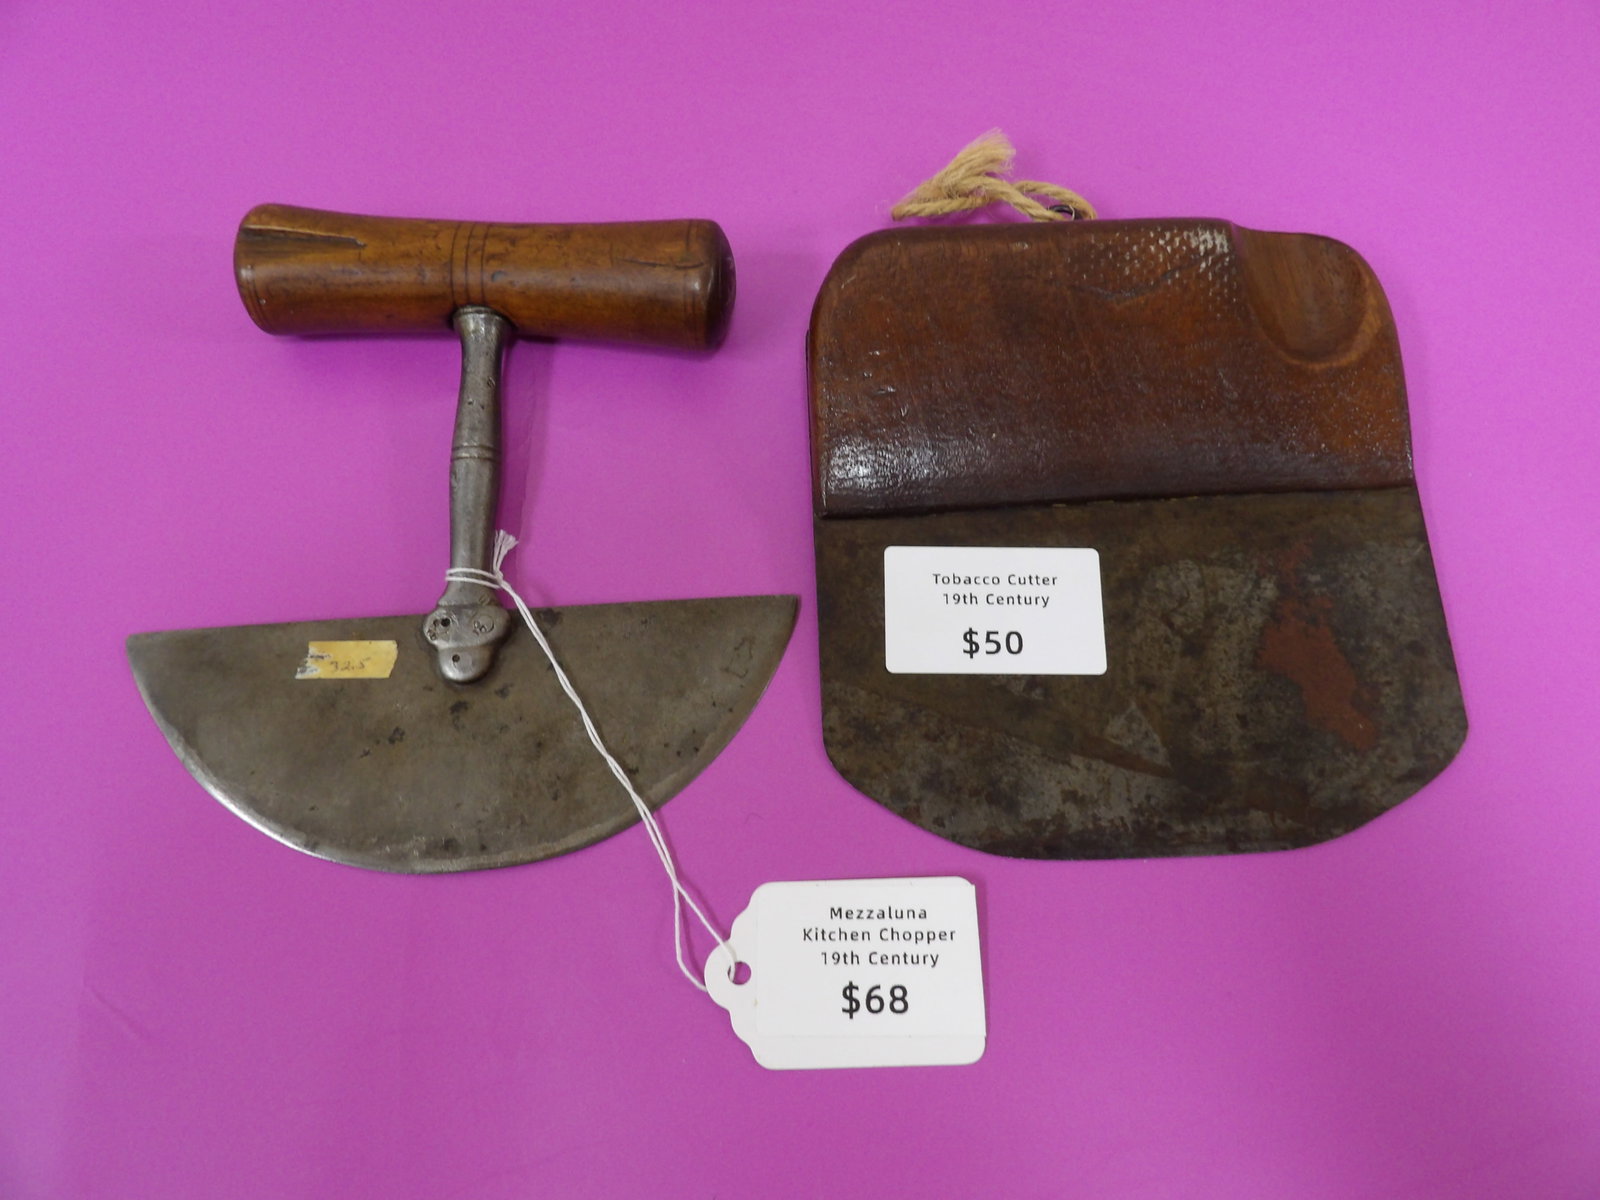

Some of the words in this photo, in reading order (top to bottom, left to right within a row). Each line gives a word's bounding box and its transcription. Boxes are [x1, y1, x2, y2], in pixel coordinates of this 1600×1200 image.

[932, 572, 1001, 586] Tobacco
[1007, 573, 1058, 586] Cutter
[943, 592, 979, 606] 19th
[985, 593, 1050, 609] Century
[962, 626, 1024, 660] $50
[829, 905, 928, 920] Mezzaluna
[802, 927, 872, 942] Kitchen
[879, 927, 957, 945] Chopper
[821, 951, 860, 966] 19th
[868, 951, 940, 969] Century
[841, 980, 910, 1020] $68
